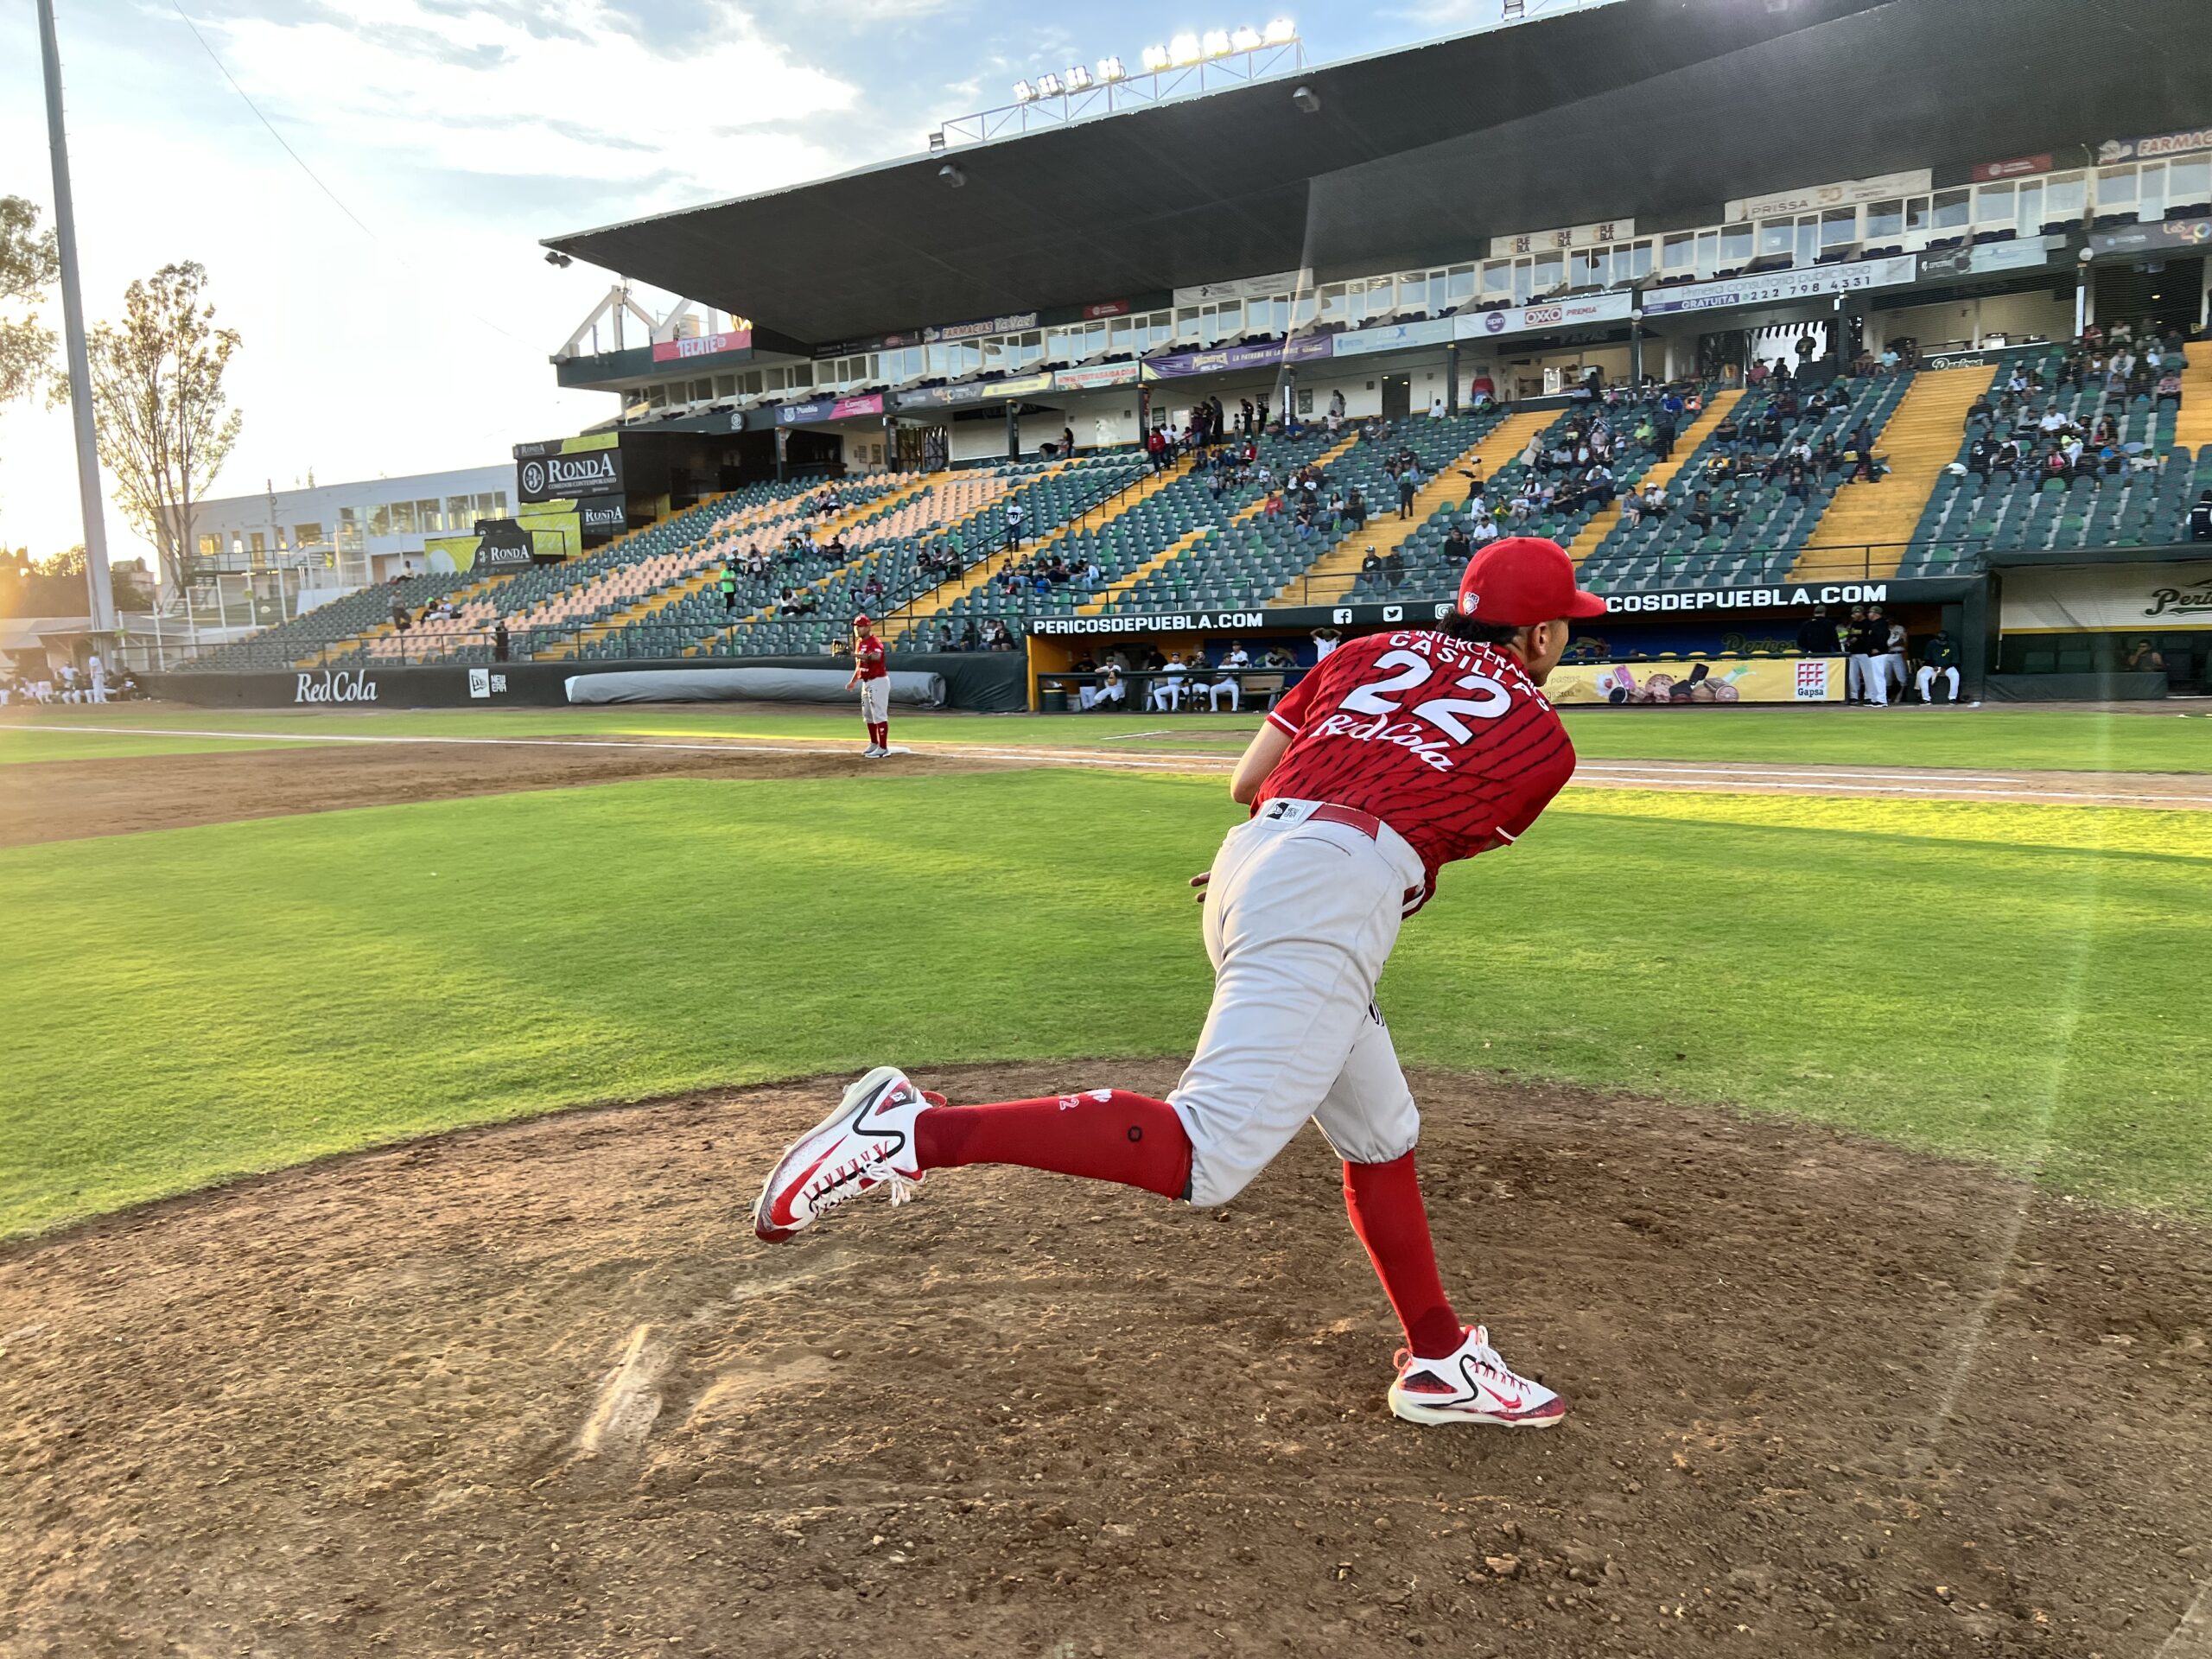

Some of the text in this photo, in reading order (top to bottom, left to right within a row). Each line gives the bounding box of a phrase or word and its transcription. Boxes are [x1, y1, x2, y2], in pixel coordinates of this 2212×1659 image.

[1751, 200, 1808, 216] PRISSA
[1681, 276, 1870, 309] GRATUITA 222 798 4331
[1487, 316, 1504, 327] spin
[1525, 307, 1598, 325] OXXO PREMIA
[942, 321, 994, 340] FARMACIAS
[677, 334, 719, 358] TECATE
[547, 453, 616, 483] RONDA
[585, 505, 624, 523] RONDA
[491, 544, 531, 561] RONDA
[1601, 584, 1887, 613] COSDEPUEBLA.COM
[1033, 613, 1263, 634] PERICOSDEPUEBLA.COM
[1723, 632, 1796, 654] Pericos
[491, 675, 506, 683] NEW
[1389, 633, 1549, 711] CASILLAS
[491, 683, 507, 692] ERA
[1798, 688, 1824, 697] Gapsa
[1338, 650, 1511, 745] 22
